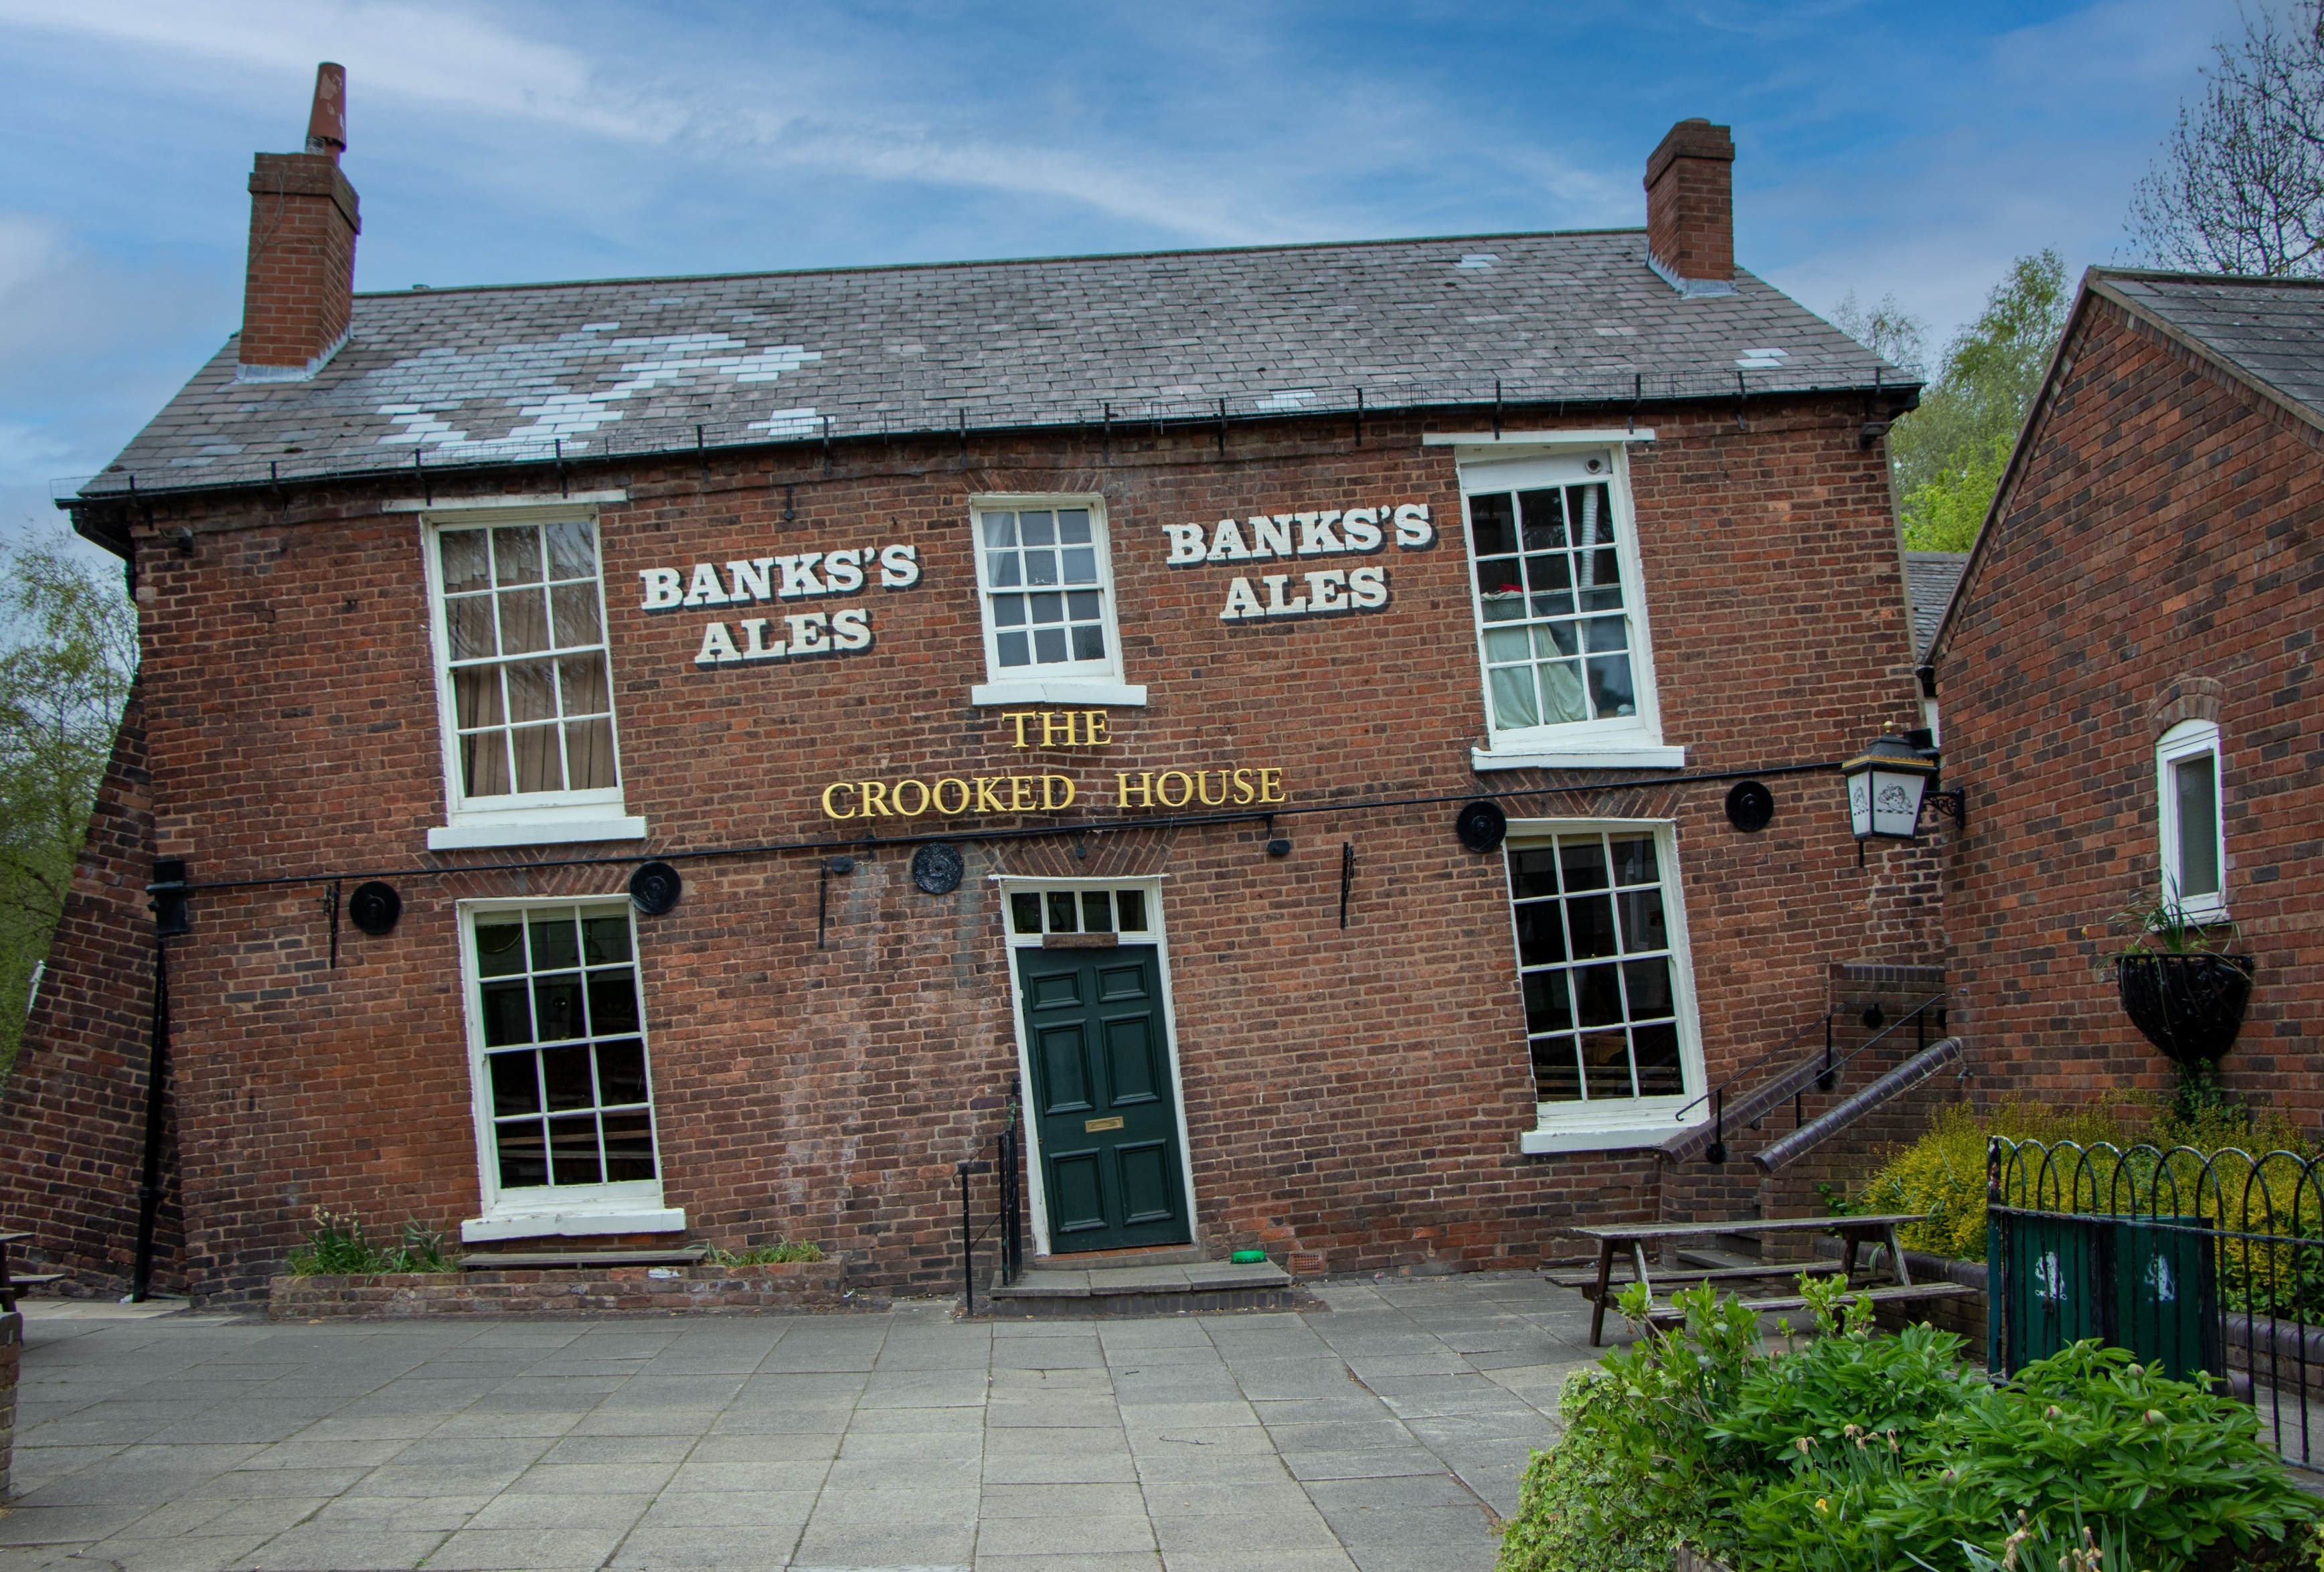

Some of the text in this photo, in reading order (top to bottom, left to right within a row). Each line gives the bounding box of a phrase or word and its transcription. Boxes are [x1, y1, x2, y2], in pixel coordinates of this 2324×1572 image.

[1162, 503, 1432, 564] BANKS'S
[639, 545, 919, 610] BANKS'S
[1220, 567, 1388, 619] ALES
[694, 609, 871, 664] ALES
[1003, 710, 1112, 748] THE
[822, 767, 1286, 819] CROOKED HOUSE
